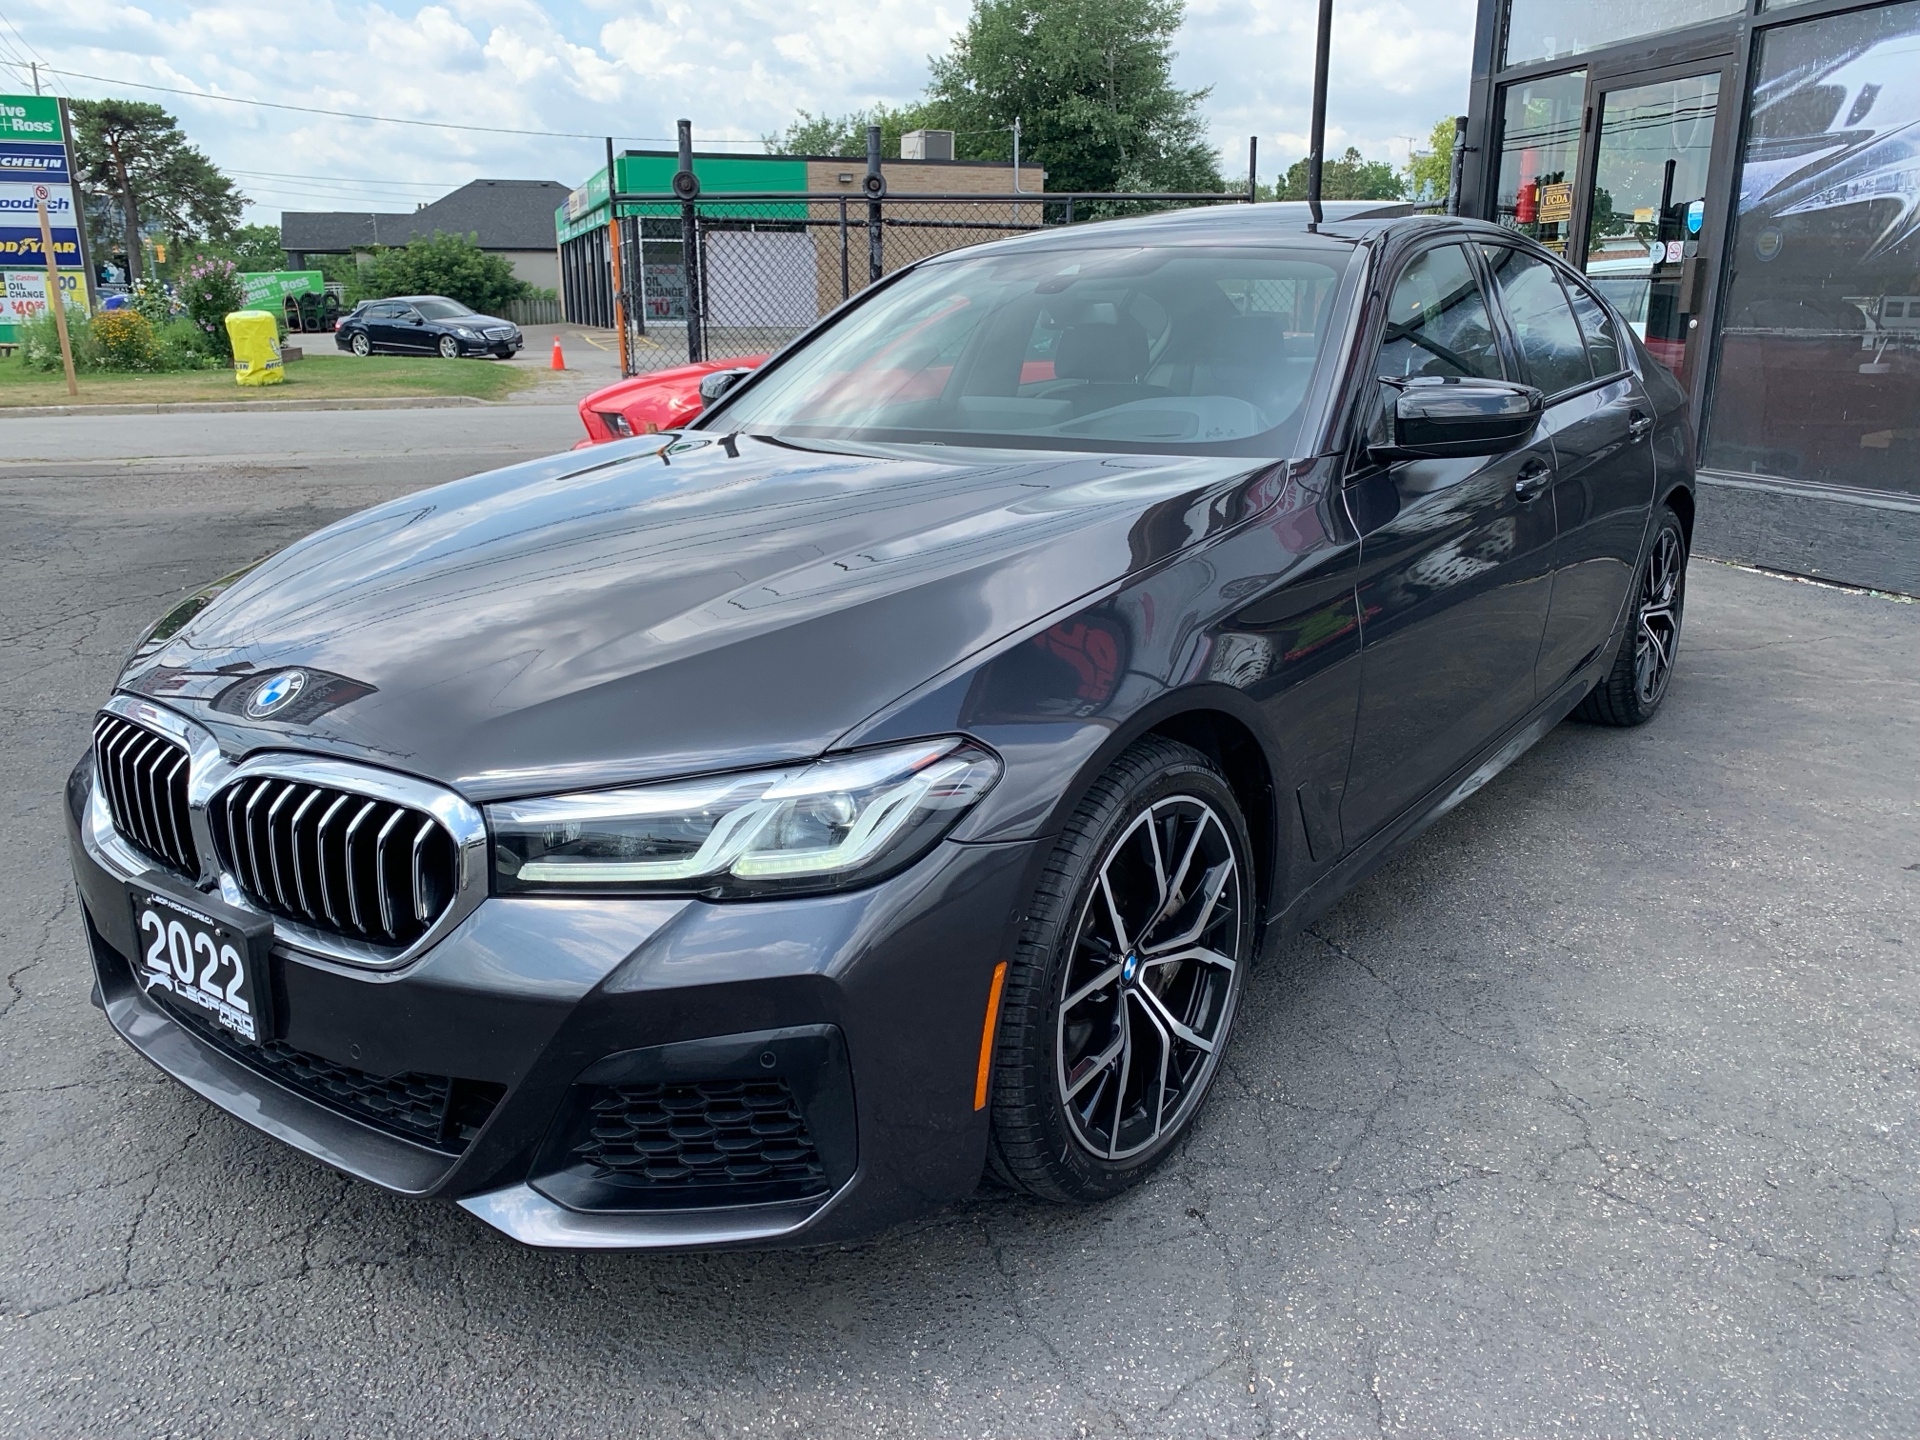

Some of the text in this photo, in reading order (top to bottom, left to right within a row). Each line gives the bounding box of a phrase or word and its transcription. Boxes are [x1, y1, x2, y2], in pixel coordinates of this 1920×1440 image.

[12, 118, 53, 132] Ross
[0, 157, 62, 168] CHELIN
[1546, 194, 1568, 205] UCDA
[8, 282, 26, 290] OIL
[280, 277, 309, 292] Ross
[645, 276, 662, 287] OIL
[9, 290, 45, 299] CHANGE
[646, 287, 684, 298] CHANGE
[141, 910, 250, 1014] 2022
[174, 978, 255, 1033] LEOPARD
[218, 1015, 256, 1042] MOTORS
